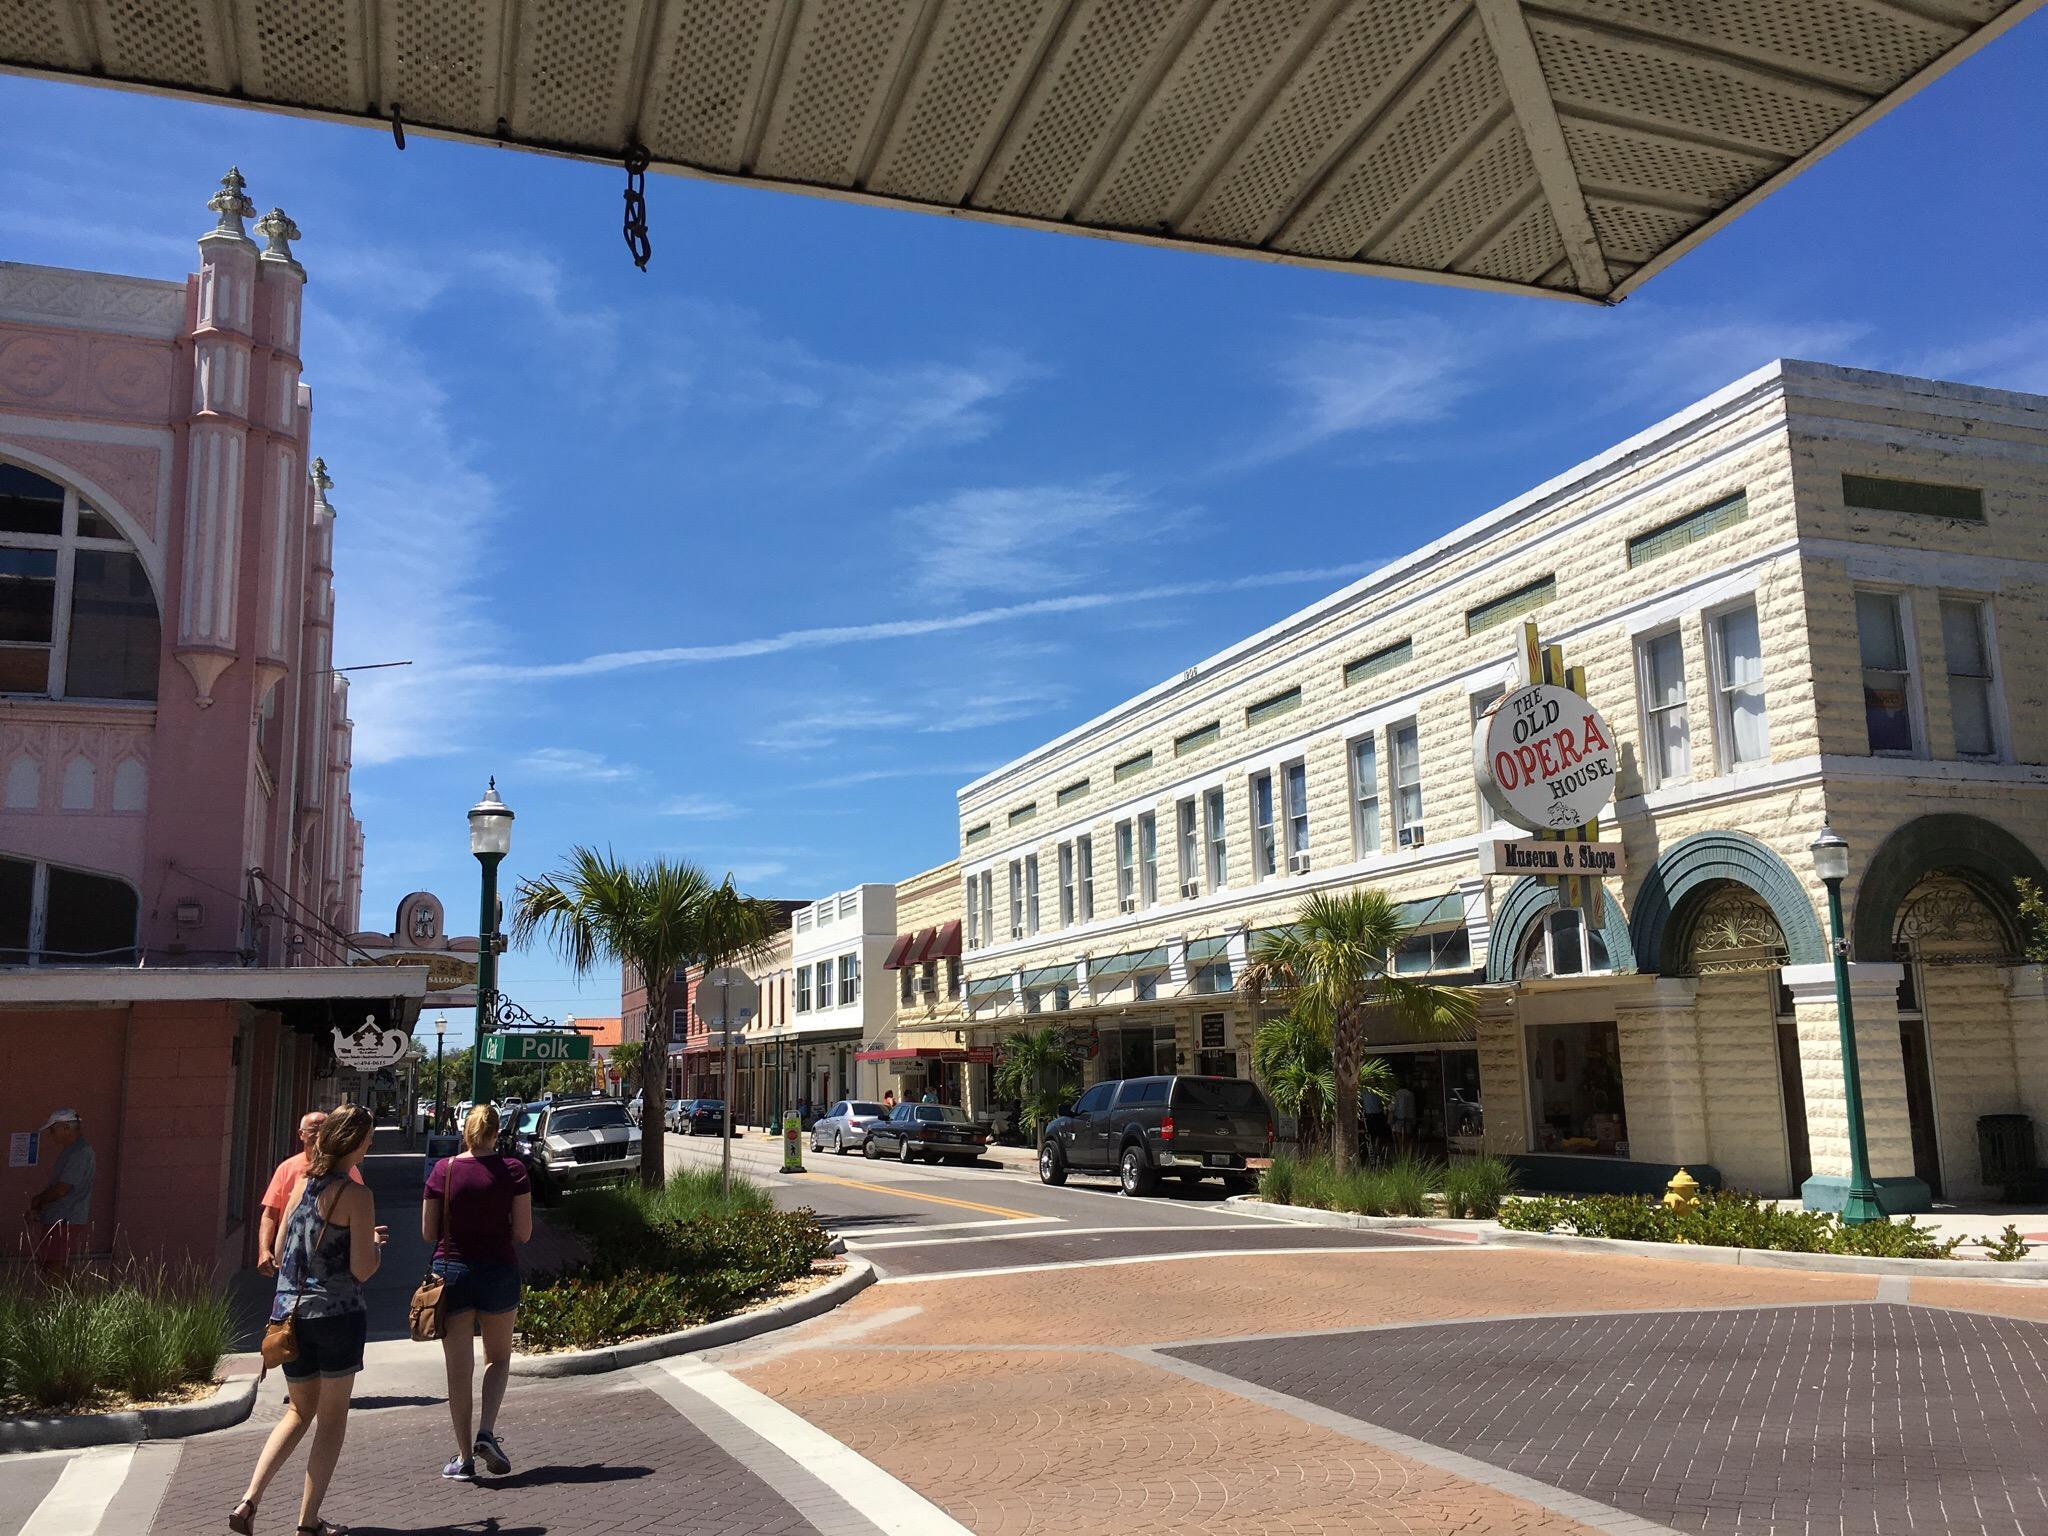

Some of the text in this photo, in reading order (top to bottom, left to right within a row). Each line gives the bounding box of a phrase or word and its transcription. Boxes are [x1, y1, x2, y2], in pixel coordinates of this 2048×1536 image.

[1513, 687, 1543, 716] THE
[1512, 699, 1560, 744] OLD
[1495, 714, 1609, 791] OPERA
[1546, 758, 1614, 800] HOUSE
[1504, 843, 1615, 874] Museum & Shops
[428, 976, 463, 984] SALOON
[522, 1037, 570, 1058] Polk
